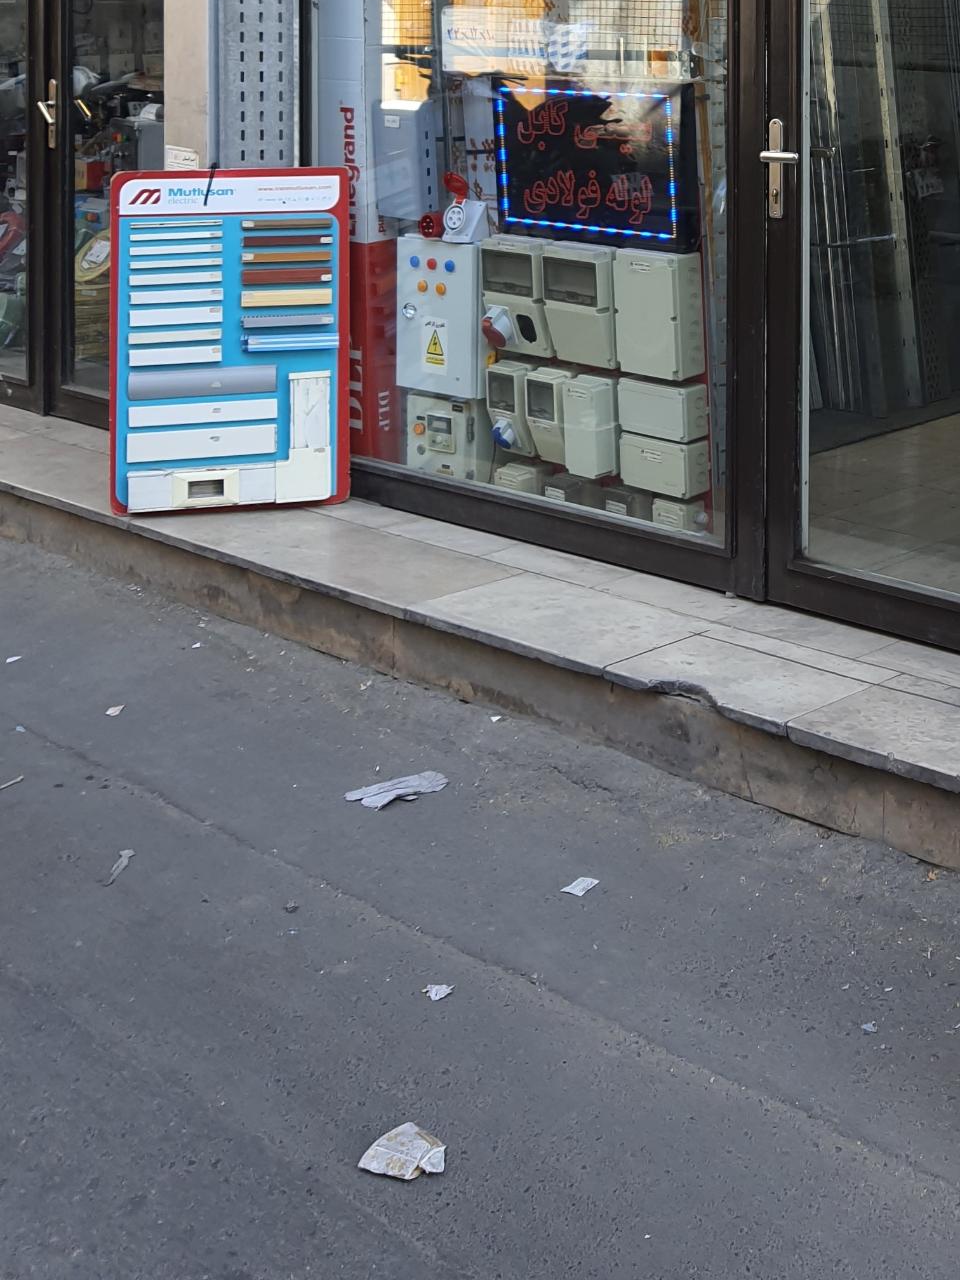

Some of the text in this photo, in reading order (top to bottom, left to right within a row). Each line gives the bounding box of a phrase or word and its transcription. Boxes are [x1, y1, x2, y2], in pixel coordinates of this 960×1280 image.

[517, 101, 568, 151] کابل
[168, 197, 198, 205] electric
[524, 170, 652, 225] لوله فولادی
